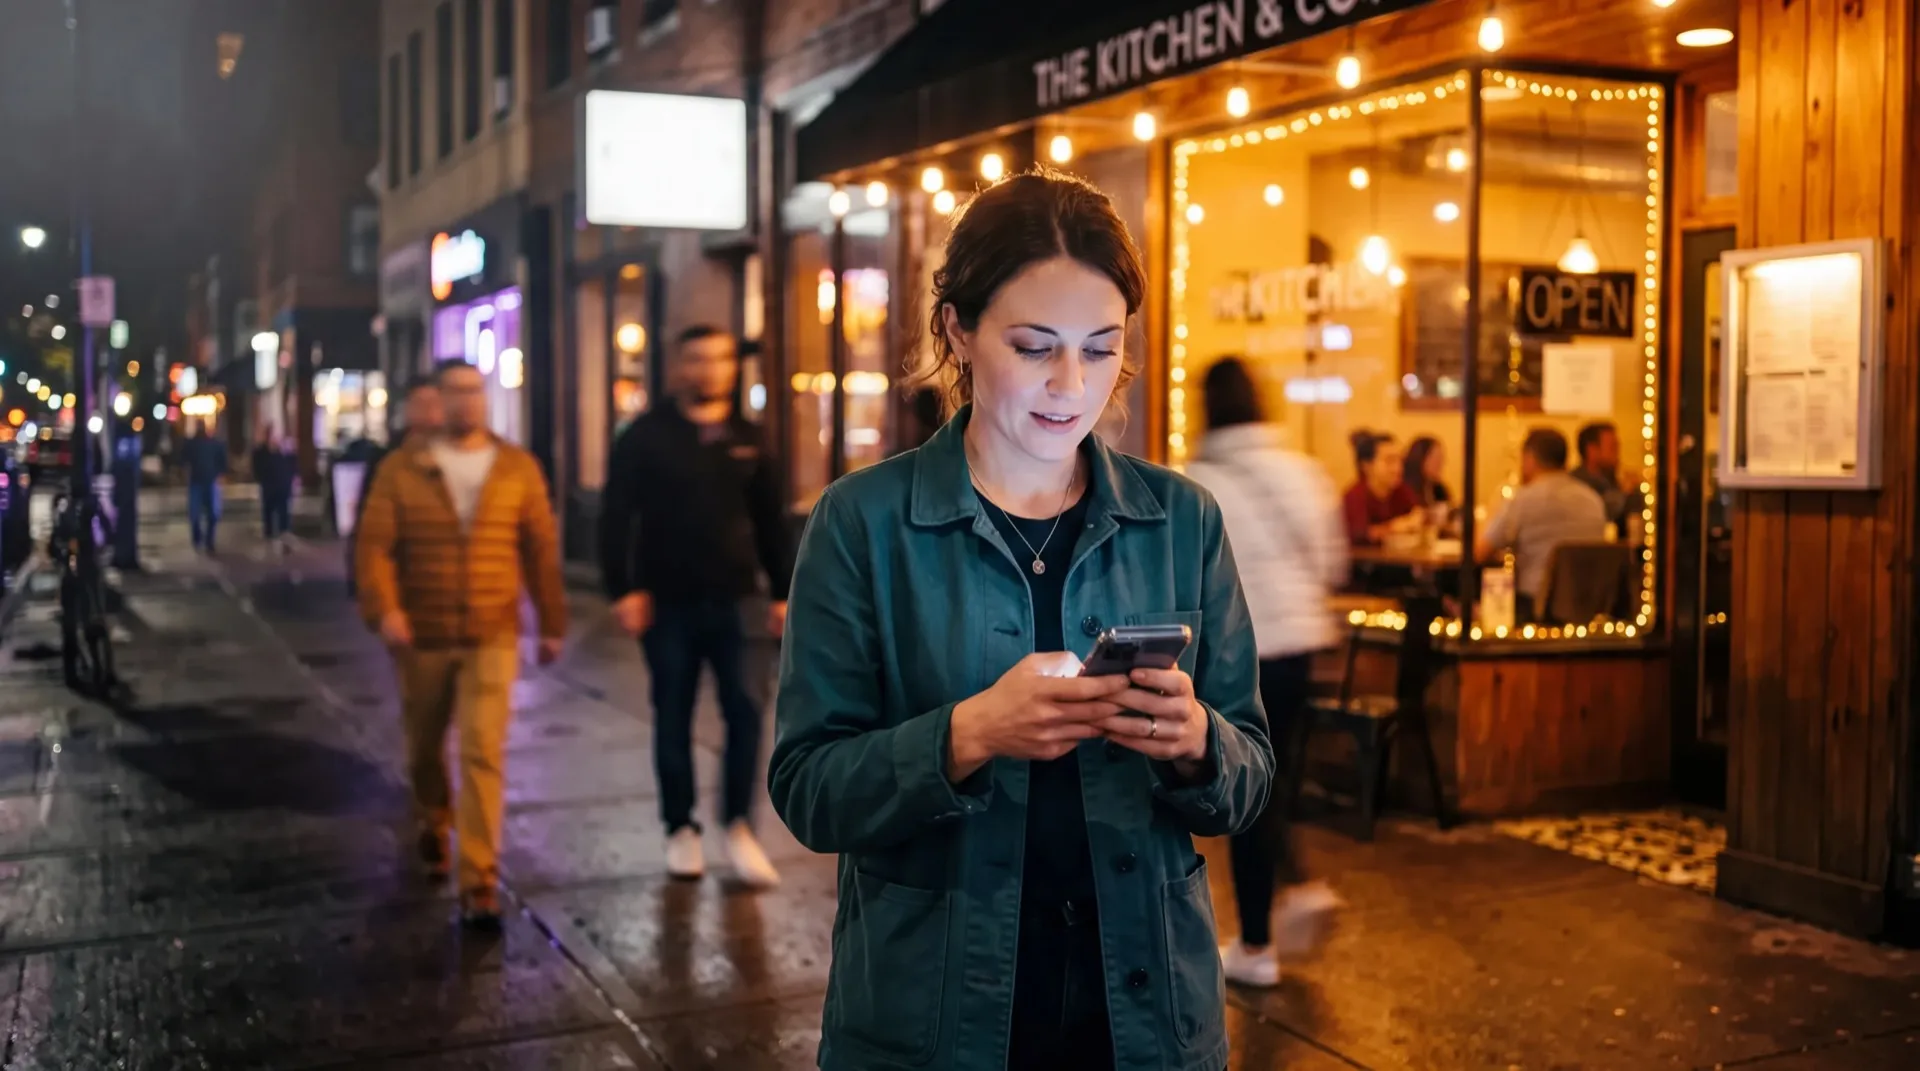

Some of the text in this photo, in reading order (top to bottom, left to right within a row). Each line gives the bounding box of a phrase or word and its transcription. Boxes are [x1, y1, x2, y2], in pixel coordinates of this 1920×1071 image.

[1033, 47, 1090, 107] THE
[1096, 0, 1244, 91] KITCHEN
[1255, 0, 1284, 38] &
[1525, 275, 1629, 329] OPEN
